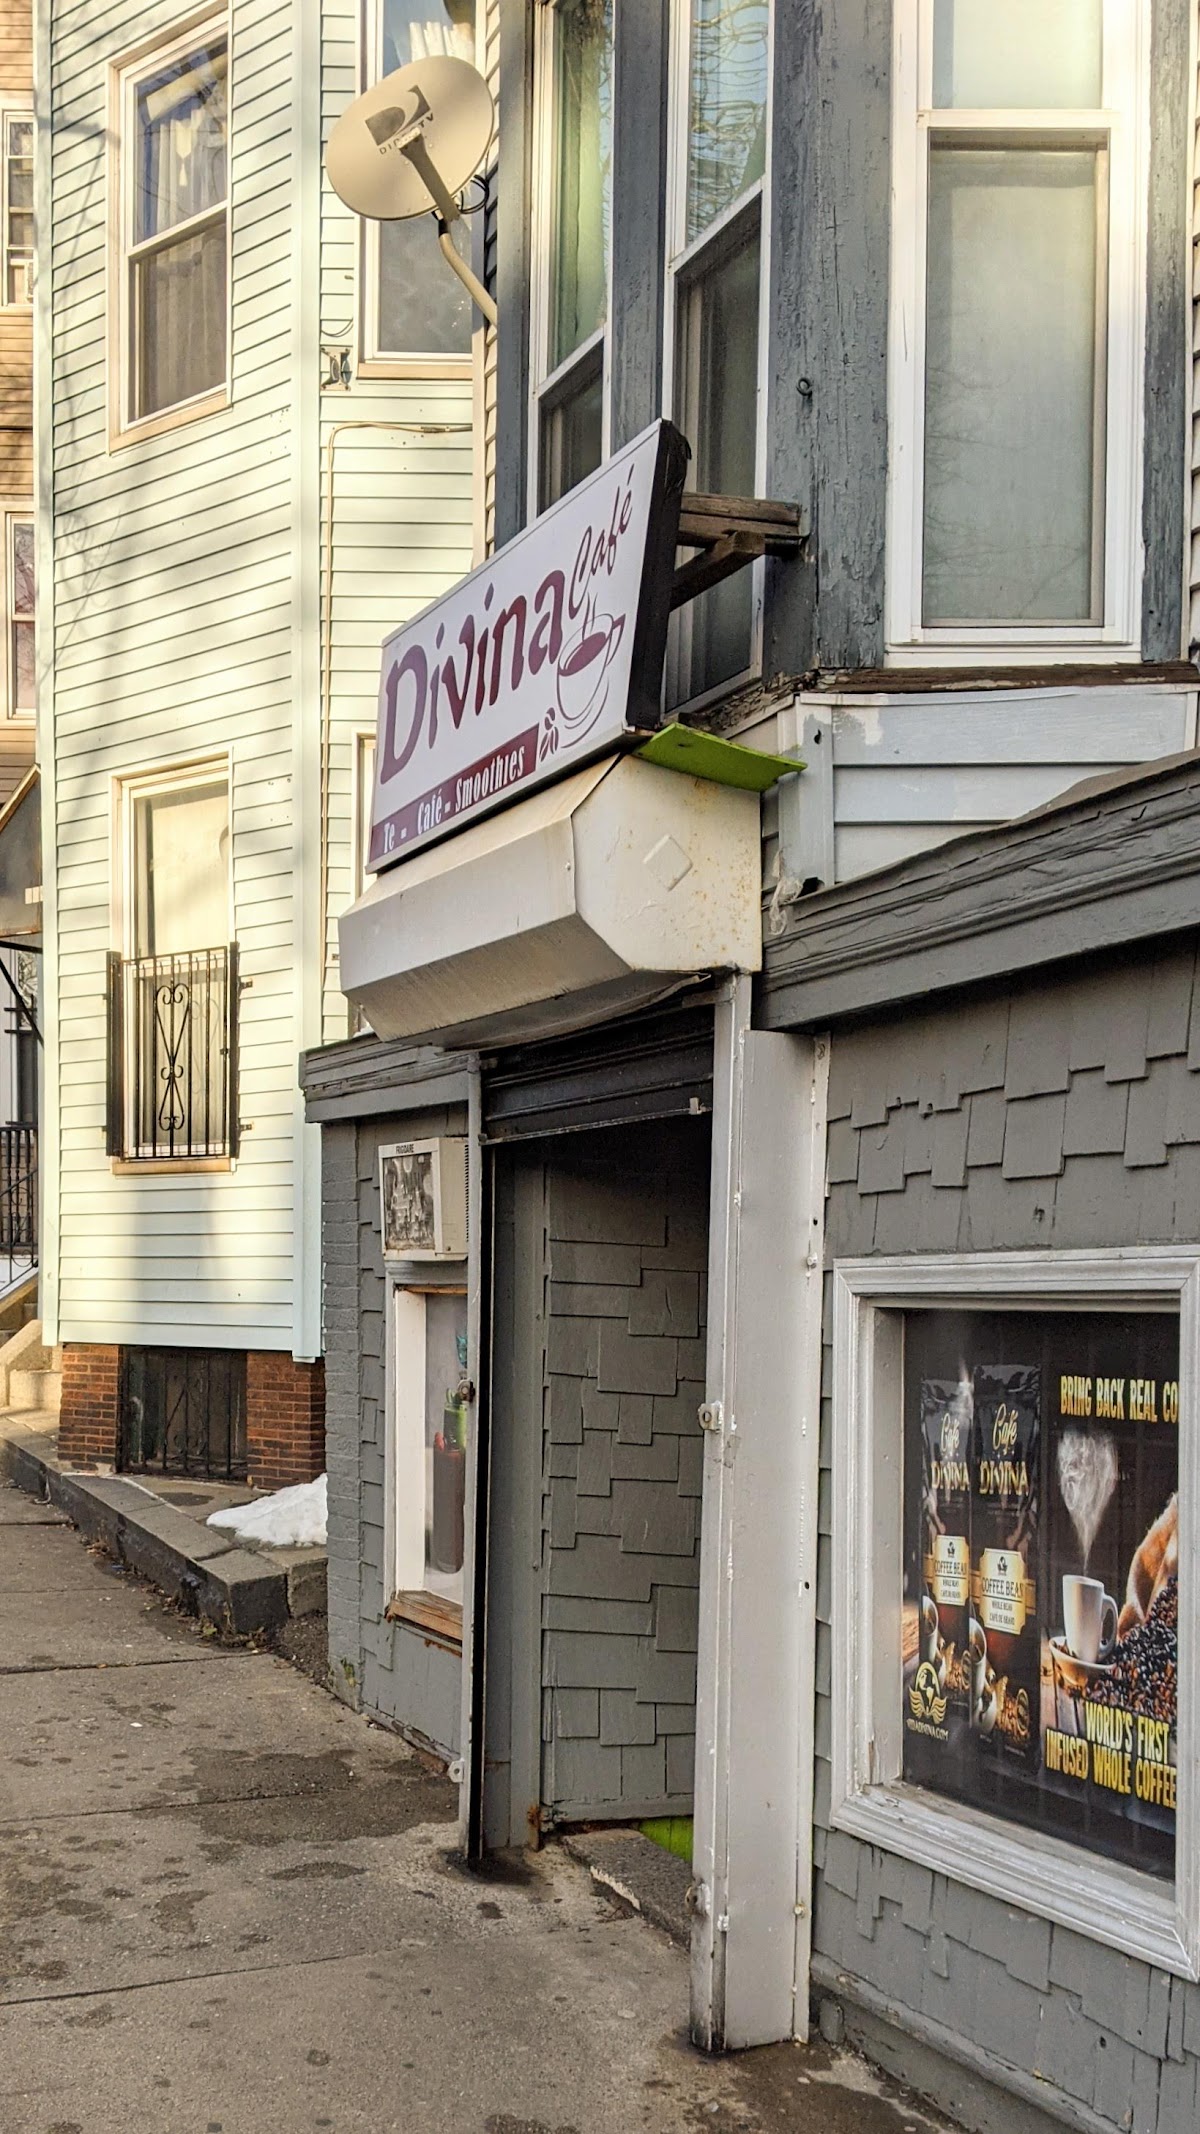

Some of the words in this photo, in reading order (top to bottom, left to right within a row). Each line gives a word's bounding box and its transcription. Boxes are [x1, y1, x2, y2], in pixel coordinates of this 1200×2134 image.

[569, 463, 634, 620] Café
[380, 570, 566, 785] Divina
[384, 822, 396, 854] Te
[418, 788, 443, 835] Café
[455, 746, 525, 813] Smoothies
[1060, 1375, 1092, 1416] BRING
[1096, 1377, 1125, 1420] BACK
[1129, 1379, 1158, 1422] REAL
[1163, 1381, 1179, 1423] CO
[979, 1460, 1029, 1496] DIVINA
[982, 1577, 1005, 1596] COFFEE
[1046, 1728, 1089, 1780] INFUSED
[1093, 1743, 1132, 1795] WHOLE
[1085, 1701, 1133, 1753] WORLD'S
[1138, 1715, 1169, 1765] FIRST
